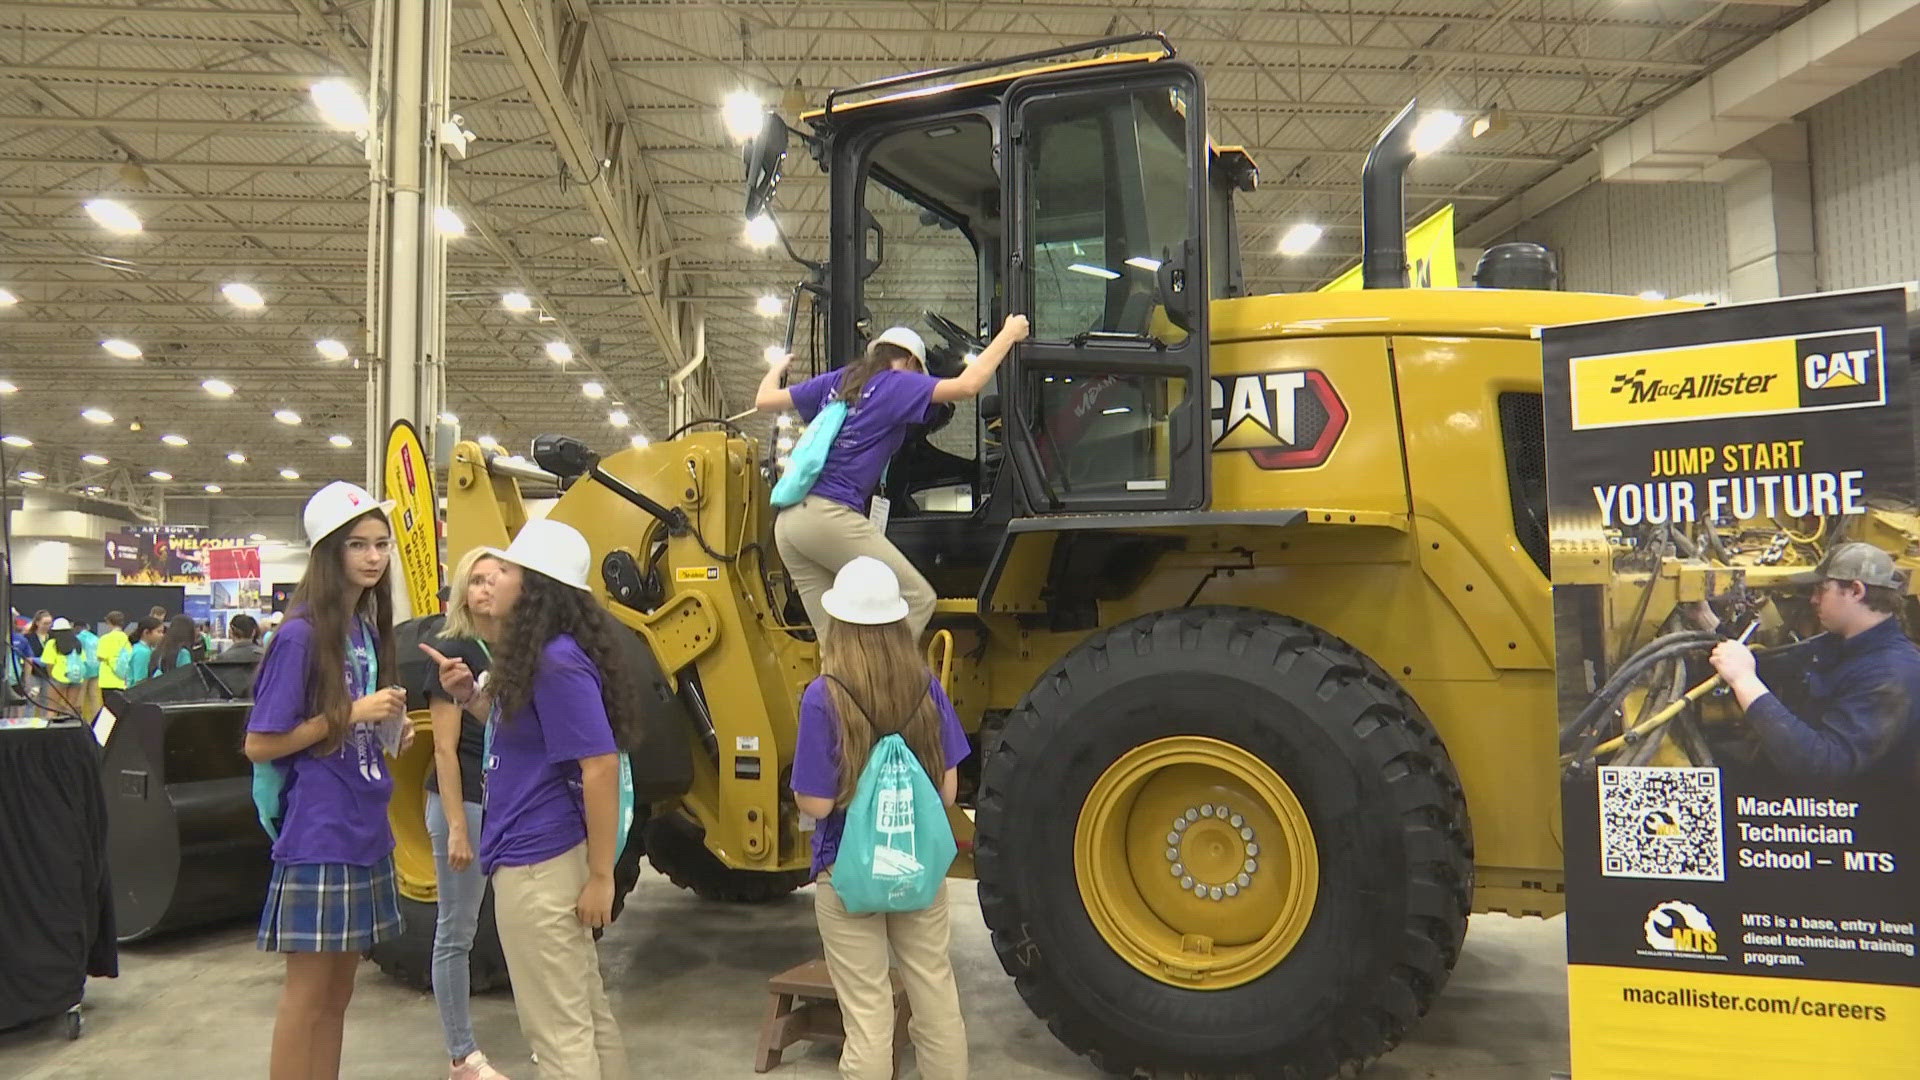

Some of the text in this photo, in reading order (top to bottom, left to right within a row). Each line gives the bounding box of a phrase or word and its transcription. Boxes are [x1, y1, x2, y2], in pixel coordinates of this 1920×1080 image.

[1804, 349, 1873, 389] CAT
[1628, 372, 1778, 404] MacAllister
[1651, 440, 1804, 477] JUMP START
[1593, 470, 1867, 527] YOUR FUTURE
[1736, 796, 1858, 818] MacAllister
[1737, 821, 1853, 844] Technician
[1738, 849, 1811, 869] School
[1844, 852, 1895, 873] MTS
[1741, 913, 1915, 935] MTS is a base, entry level
[1672, 928, 1718, 954] MTS
[1742, 932, 1915, 957] diesel technician training
[1743, 952, 1805, 967] program.
[1622, 986, 1887, 1022] macallister.com/careers
